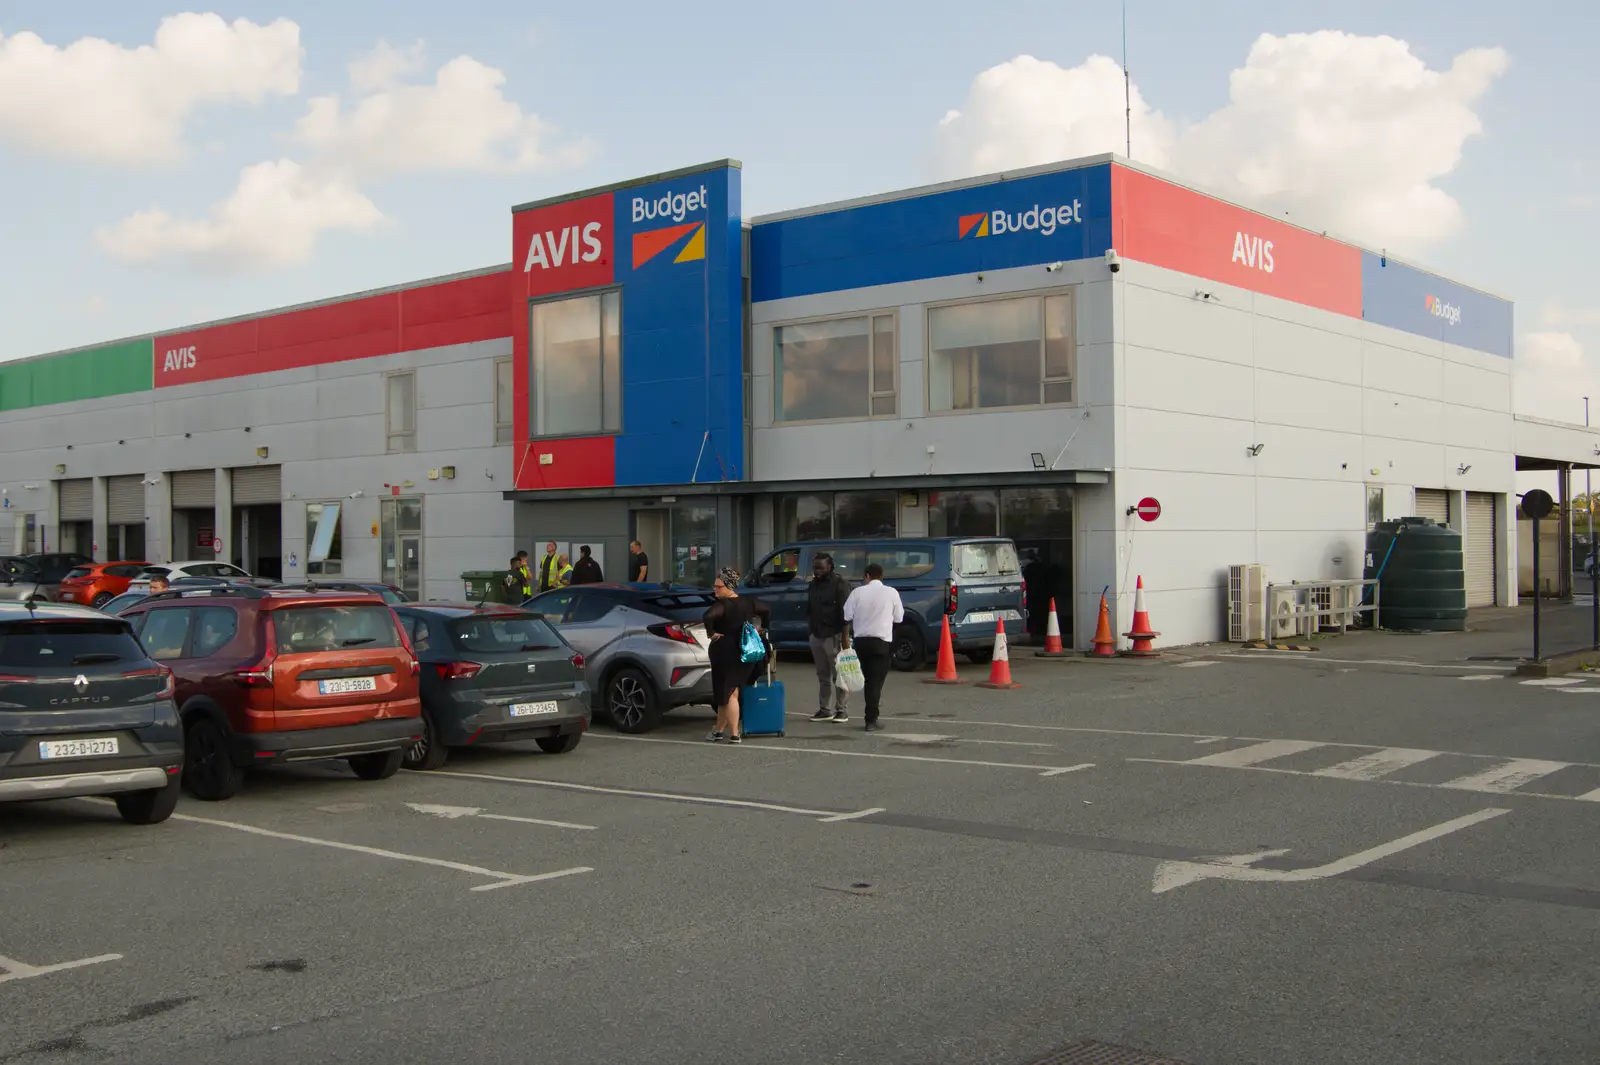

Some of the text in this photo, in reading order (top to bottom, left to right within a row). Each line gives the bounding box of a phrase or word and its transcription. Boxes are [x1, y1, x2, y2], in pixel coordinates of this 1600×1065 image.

[632, 184, 707, 222] Budget
[992, 199, 1081, 235] Budget
[523, 221, 601, 272] AVIS
[1231, 231, 1274, 273] AVIS
[1436, 298, 1460, 325] Budget
[163, 345, 196, 372] AVIS
[329, 679, 371, 692] 231-D-5828
[54, 741, 114, 757] 232-D-1273
